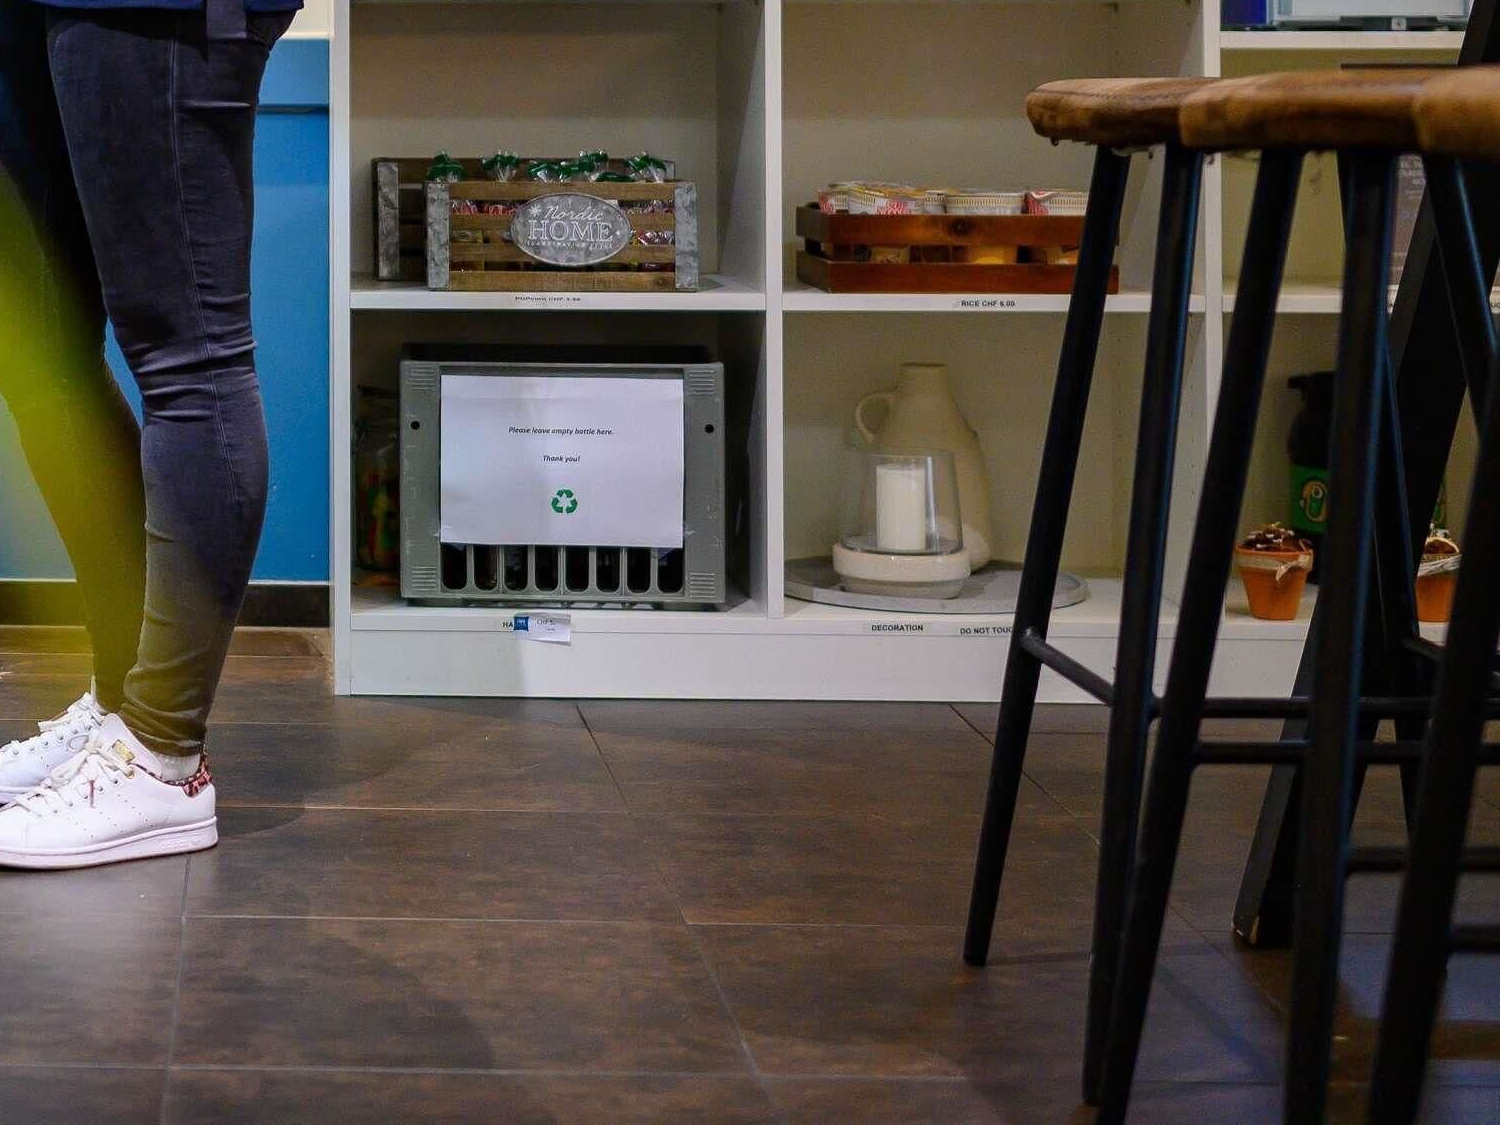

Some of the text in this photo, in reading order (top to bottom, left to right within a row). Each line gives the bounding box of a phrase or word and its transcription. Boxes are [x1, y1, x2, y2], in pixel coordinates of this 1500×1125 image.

[544, 203, 605, 221] Nordic
[528, 219, 613, 242] HOME
[961, 299, 980, 307] RICE
[981, 299, 998, 307] CHF
[508, 426, 531, 434] Please
[551, 428, 574, 436] empty
[574, 427, 596, 435] bottle
[565, 455, 581, 463] you!
[871, 624, 923, 632] DECORATION
[960, 626, 1013, 635] DO NOT TOUC
